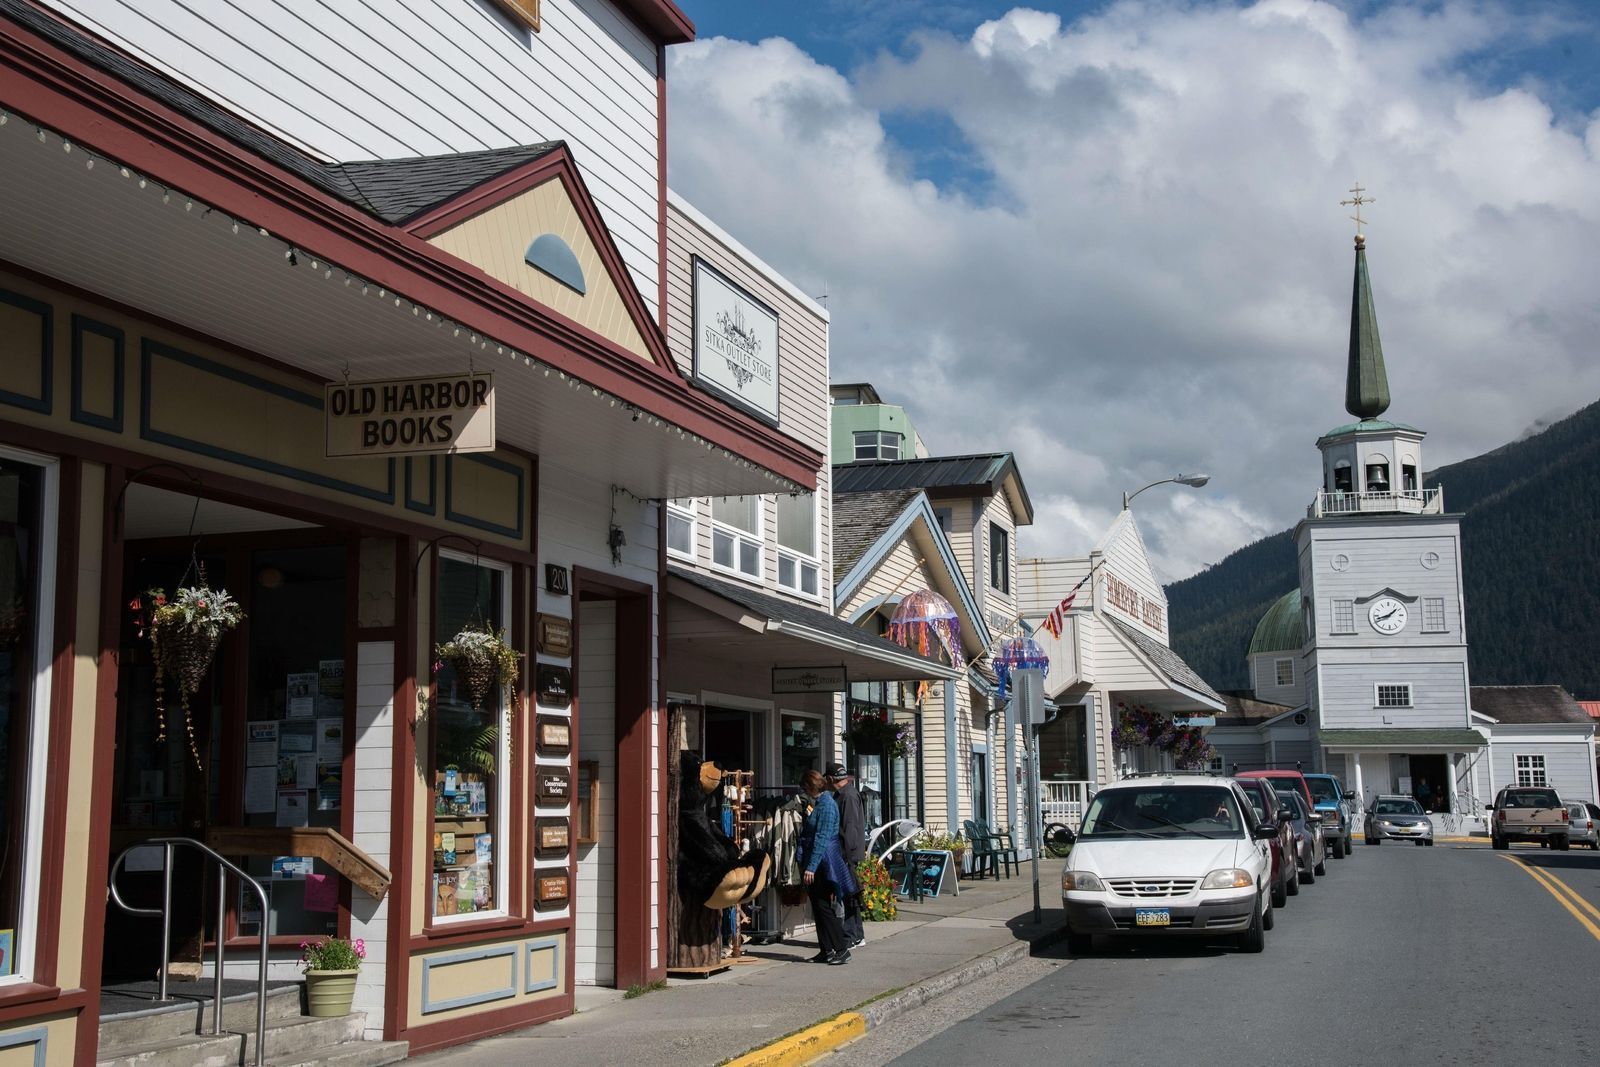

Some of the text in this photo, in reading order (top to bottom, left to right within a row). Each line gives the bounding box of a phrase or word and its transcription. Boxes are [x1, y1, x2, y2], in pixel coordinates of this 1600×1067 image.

[705, 329, 772, 382] SITKA OUTLET STORE
[331, 379, 488, 416] OLD HARBOR
[363, 415, 453, 448] BOOKS
[552, 568, 567, 591] 201
[549, 786, 563, 795] Society
[1137, 914, 1169, 922] EEF 283
